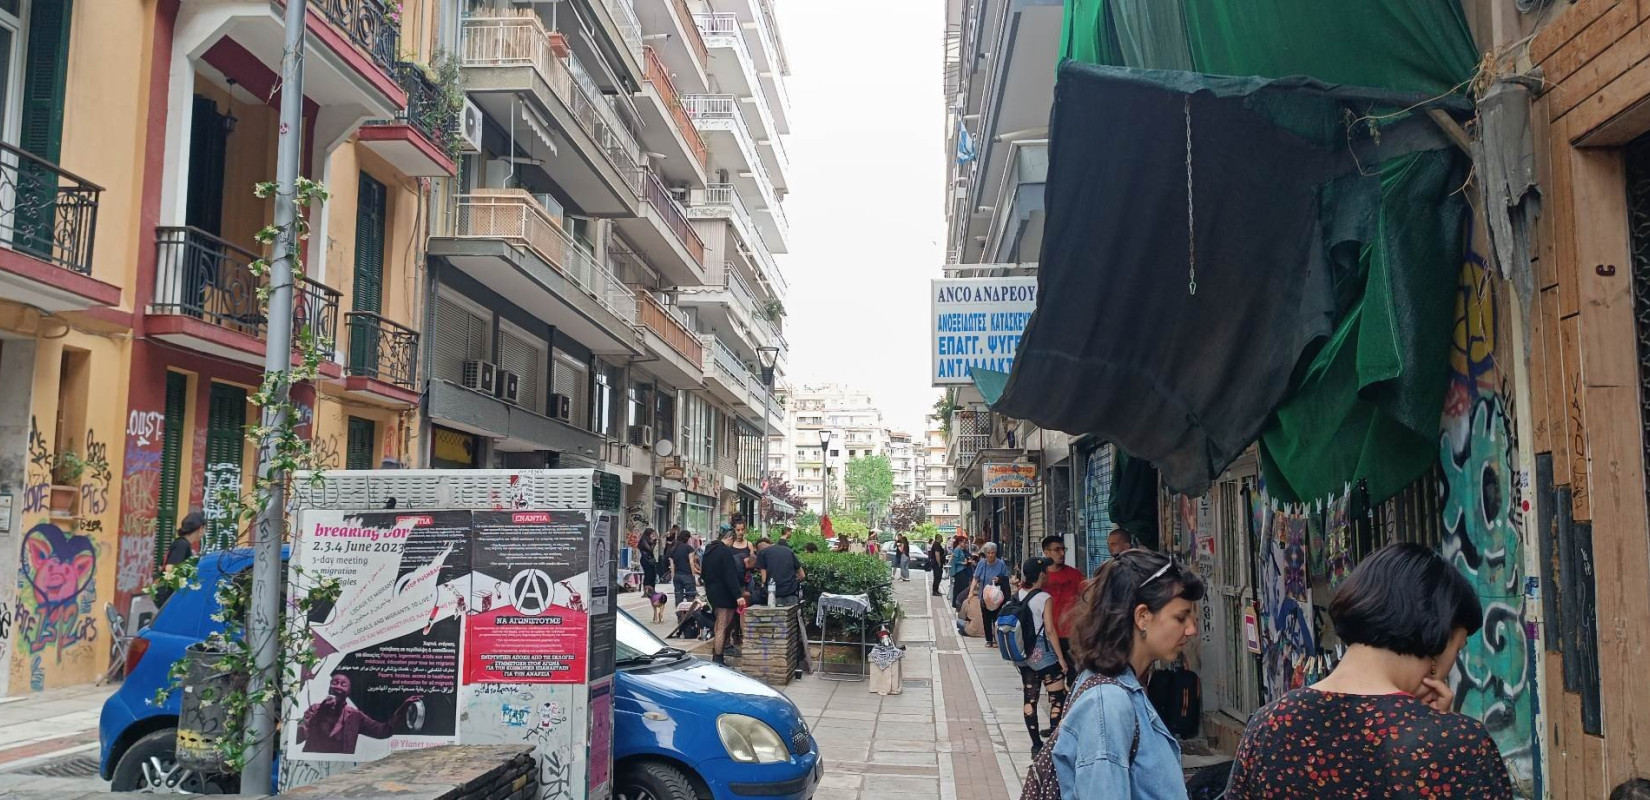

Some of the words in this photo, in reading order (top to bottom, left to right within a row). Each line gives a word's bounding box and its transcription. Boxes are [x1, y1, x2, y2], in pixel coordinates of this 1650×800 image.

[938, 313, 986, 332] ΑΝΟΞΕΙΔΩΤΕΣ
[991, 312, 1031, 331] ΚΑΤΑΣΚΕΥ
[939, 336, 982, 355] ΕΠΑΓΓ.
[81, 484, 107, 514] PIGS
[313, 542, 342, 552] 2.3.4
[344, 541, 371, 553] June
[374, 544, 405, 554] 2023
[337, 556, 368, 567] meeting
[320, 567, 356, 576] migration
[354, 623, 373, 636] LOCALS
[374, 617, 384, 626] AND
[385, 605, 410, 621] MIGRANTS
